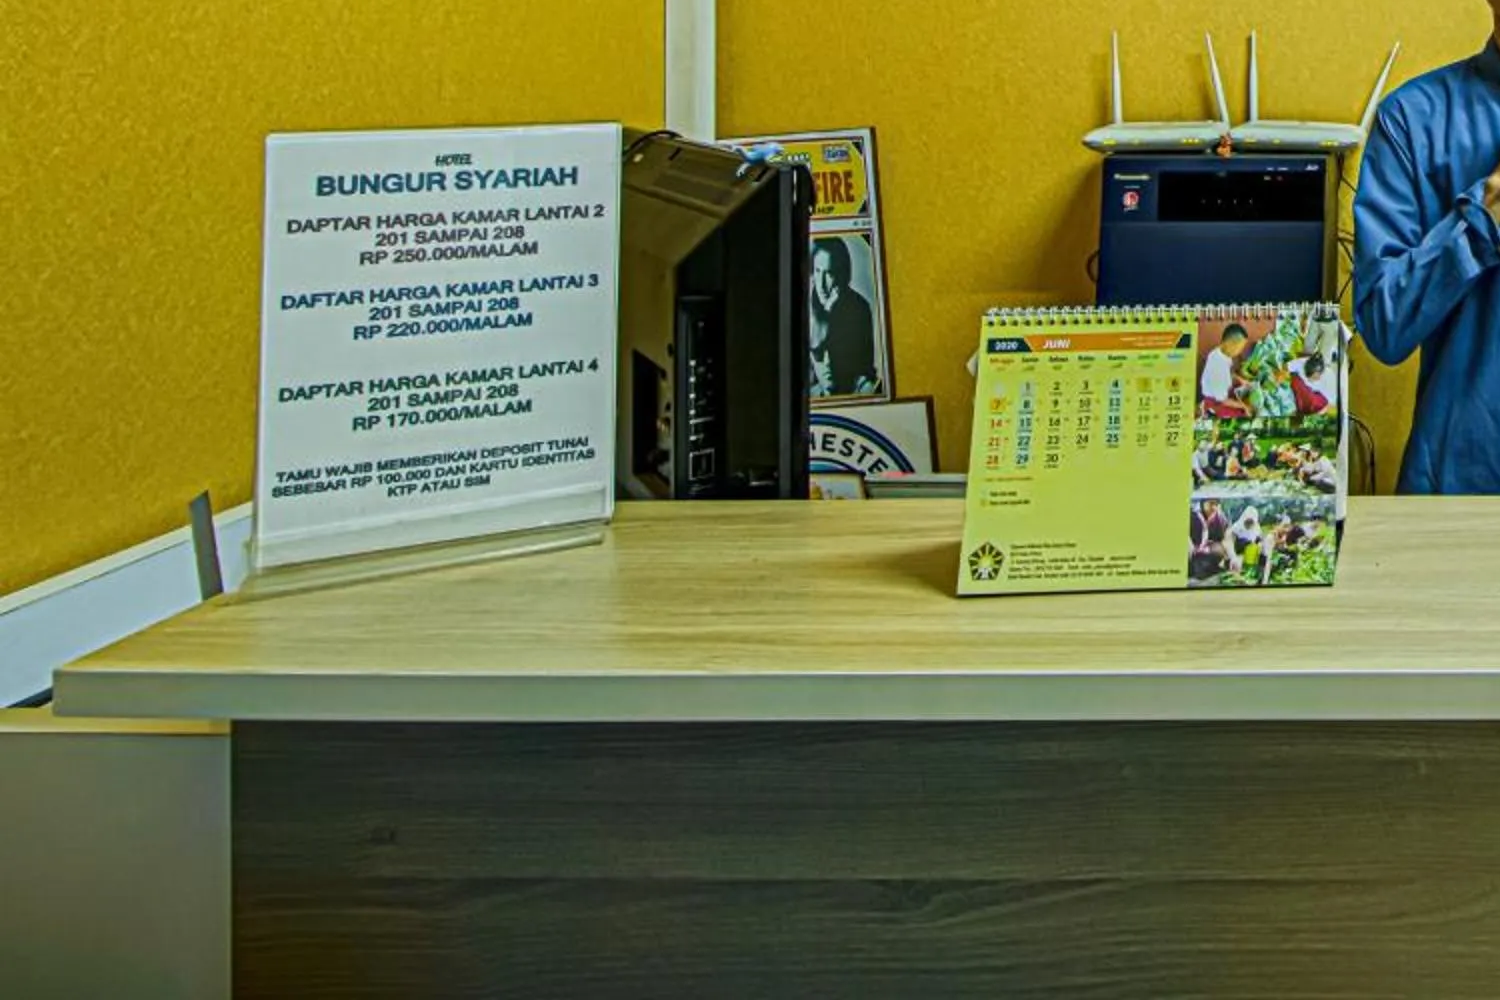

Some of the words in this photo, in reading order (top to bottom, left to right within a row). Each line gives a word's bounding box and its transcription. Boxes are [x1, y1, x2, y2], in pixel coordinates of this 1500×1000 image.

[315, 170, 446, 196] BUNGUR
[454, 166, 578, 190] SYARIAH
[286, 215, 370, 234] DAPTAR
[376, 212, 445, 230] HARGA
[451, 208, 520, 225] KAMAR
[524, 205, 589, 221] LANTAI
[592, 204, 606, 217] 2
[374, 230, 409, 246] 201
[414, 227, 489, 244] SAMPAI
[493, 225, 525, 240] 208
[358, 250, 388, 266] RP
[392, 241, 538, 264] 250.000/MALAM
[369, 287, 439, 305] HARGA
[445, 281, 513, 298] KAMAR
[518, 275, 584, 293] LANTAI
[588, 273, 599, 288] 3
[368, 305, 402, 321] 201
[408, 301, 483, 318] SAMPAI
[487, 297, 519, 312] 208
[352, 323, 381, 340] RP
[385, 313, 533, 337] 220.000/MALAM
[1043, 339, 1070, 349] JUNI
[278, 381, 364, 403] DAPTAR
[369, 375, 440, 393] HARGA
[445, 367, 513, 386] KAMAR
[518, 361, 584, 379] LANTAI
[588, 359, 599, 373] 4
[1053, 382, 1060, 390] 2
[1083, 381, 1089, 389] 3
[1112, 380, 1119, 388] 4
[367, 396, 401, 412] 201
[407, 389, 482, 407] SAMPAI
[487, 384, 519, 400] 208
[1053, 399, 1059, 407] 9
[352, 414, 381, 431] RP
[386, 399, 533, 427] 170.000/MALAM
[1077, 417, 1090, 425] 17
[1018, 436, 1030, 445] 22
[1076, 435, 1089, 444] 24
[1106, 433, 1119, 442] 25
[1166, 432, 1179, 441] 27
[276, 469, 321, 483] TAMU
[324, 463, 373, 477] WAJIB
[377, 448, 478, 471] MEMBERIKAN
[481, 441, 544, 459] DEPOSIT
[1046, 454, 1058, 463] 30
[351, 477, 374, 489] RP
[434, 463, 465, 478] DAN
[469, 457, 520, 473] KARTU
[387, 484, 417, 498] KTP
[420, 478, 461, 493] ATAU
